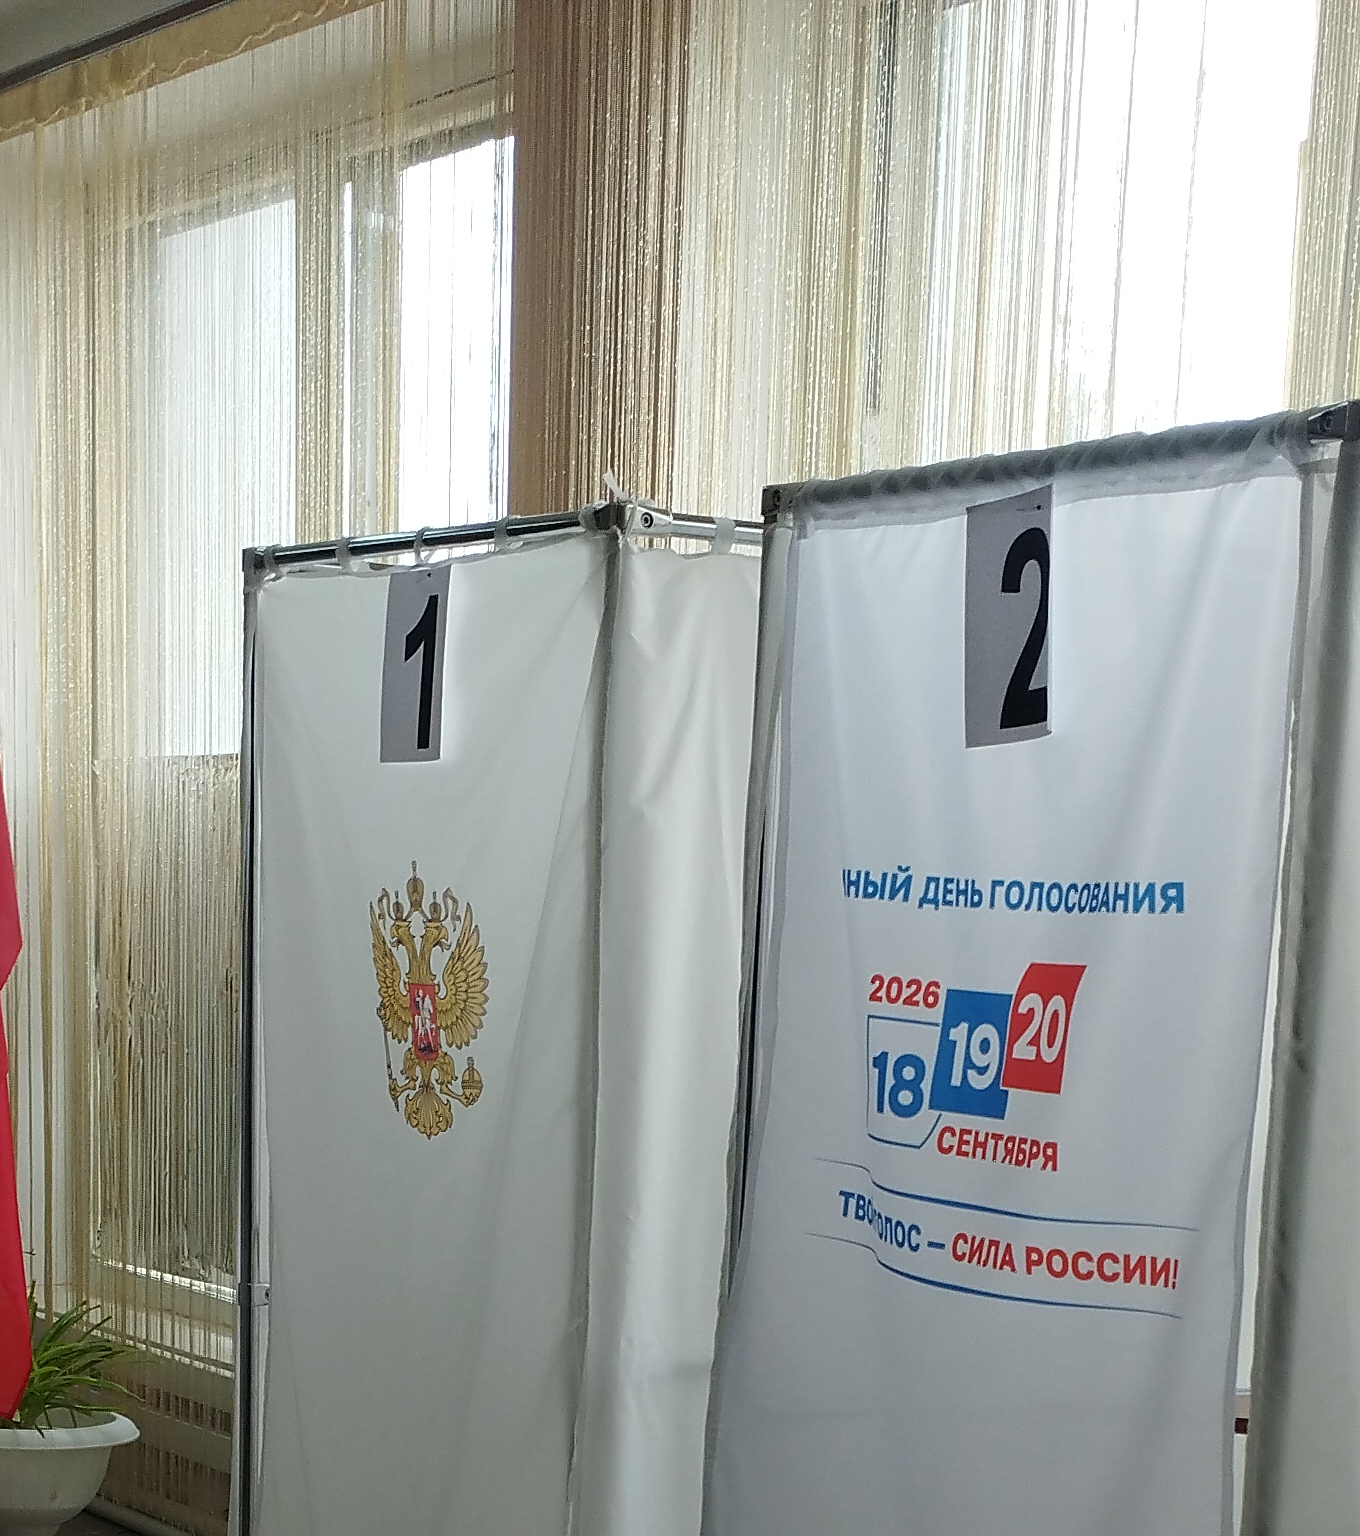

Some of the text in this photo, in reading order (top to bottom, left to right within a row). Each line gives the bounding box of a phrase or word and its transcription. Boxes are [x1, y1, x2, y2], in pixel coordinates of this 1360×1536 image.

[1000, 527, 1050, 729] 2
[404, 594, 439, 749] 1
[842, 865, 1185, 914] НЫЙ ДЕНЬ ГОЛОСОВАНИЯ
[868, 974, 940, 1009] 2026
[872, 993, 1067, 1119] 18 19 20
[937, 1126, 1058, 1172] СЕНТЯБРЯ
[873, 1207, 922, 1253] ОЛОС
[951, 1232, 1017, 1273] СИЛА
[1025, 1245, 1180, 1290] РОССИИ!
